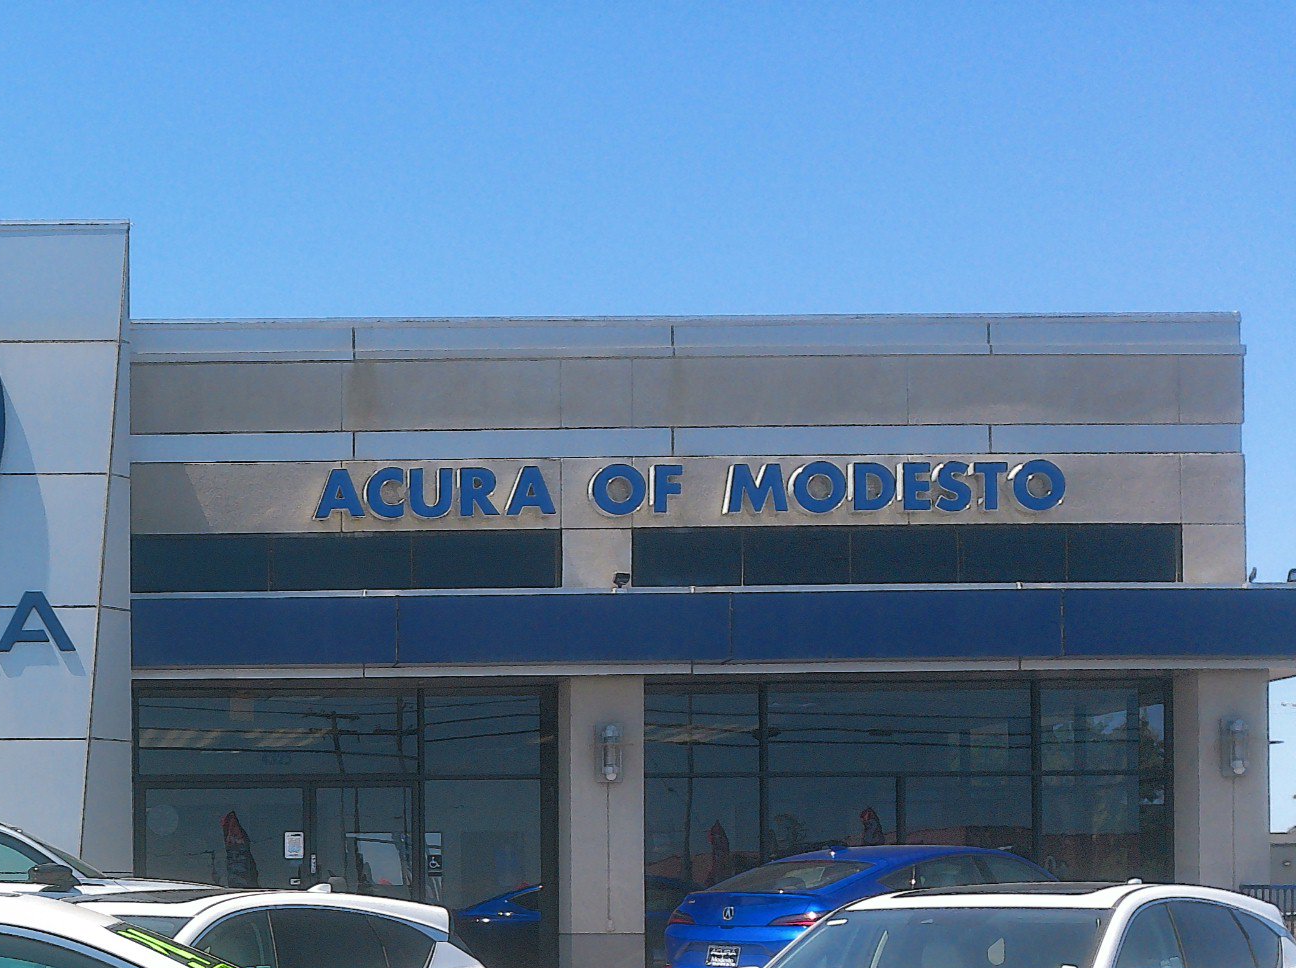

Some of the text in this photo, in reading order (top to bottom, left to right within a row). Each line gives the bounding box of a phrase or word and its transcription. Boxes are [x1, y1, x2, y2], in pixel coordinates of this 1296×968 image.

[313, 459, 1066, 520] ACURA OF MODESTO
